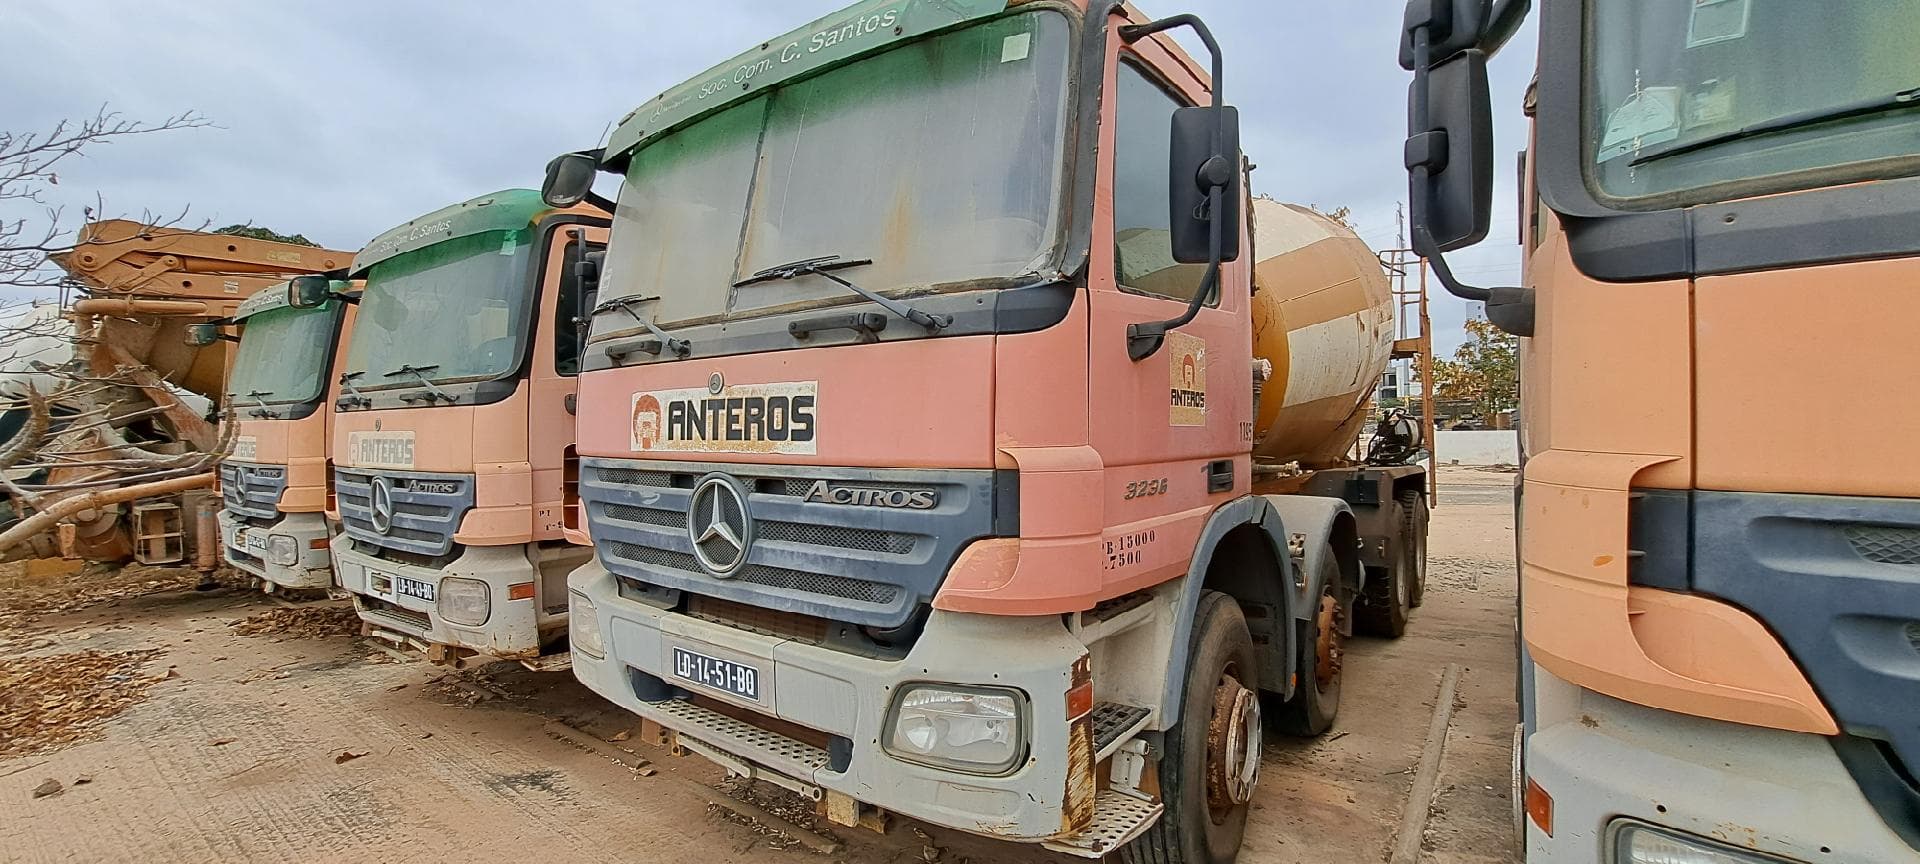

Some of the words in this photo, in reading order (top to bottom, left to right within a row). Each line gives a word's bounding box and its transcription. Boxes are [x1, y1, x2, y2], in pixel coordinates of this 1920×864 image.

[698, 78, 727, 99] Soc.
[734, 59, 772, 83] Com.
[781, 42, 801, 63] C.
[808, 9, 897, 53] Santos
[1171, 388, 1205, 407] ANTEROS
[668, 395, 814, 441] ANTEROS
[361, 438, 414, 464] ANTEROS
[1124, 478, 1168, 500] 3236
[677, 651, 755, 696] LD-14-51-BQ
